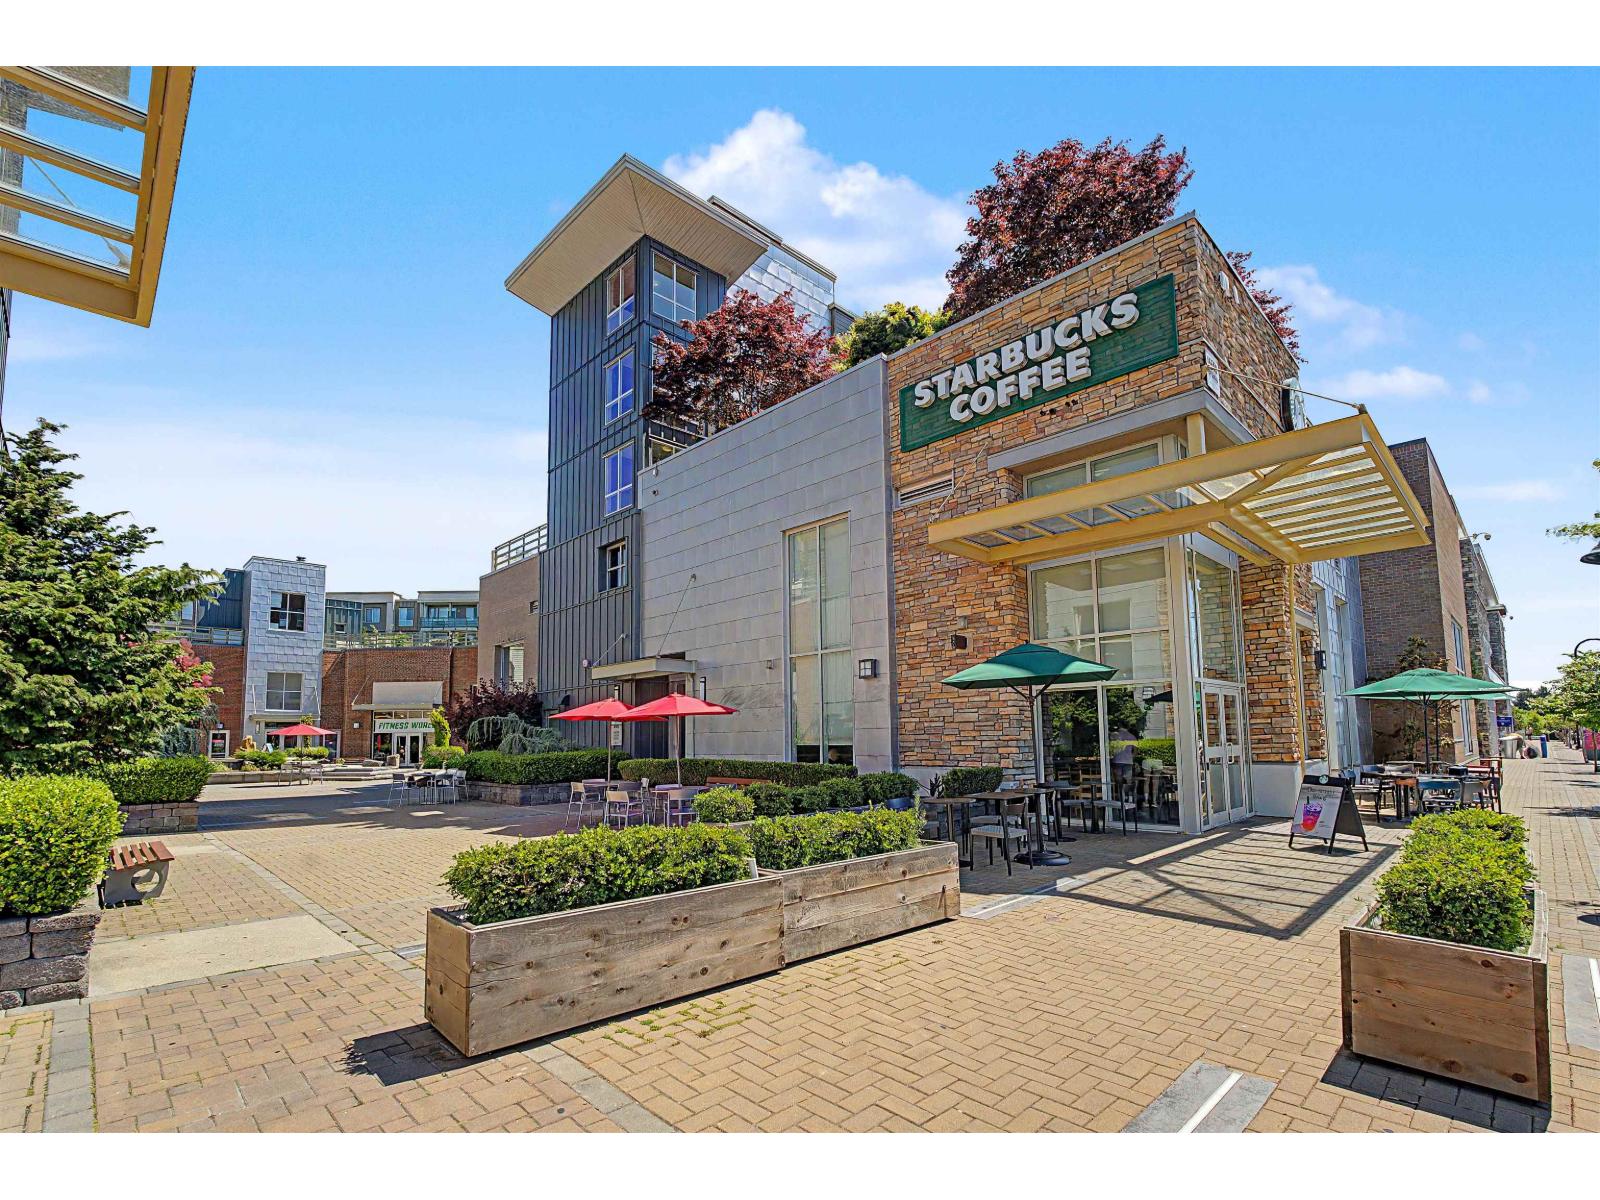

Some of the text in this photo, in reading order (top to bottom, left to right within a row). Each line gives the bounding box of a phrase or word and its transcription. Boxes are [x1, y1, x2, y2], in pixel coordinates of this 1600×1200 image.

[914, 292, 1140, 408] STARBUCKS
[949, 346, 1092, 423] COFFEE
[378, 722, 409, 730] FITNESS
